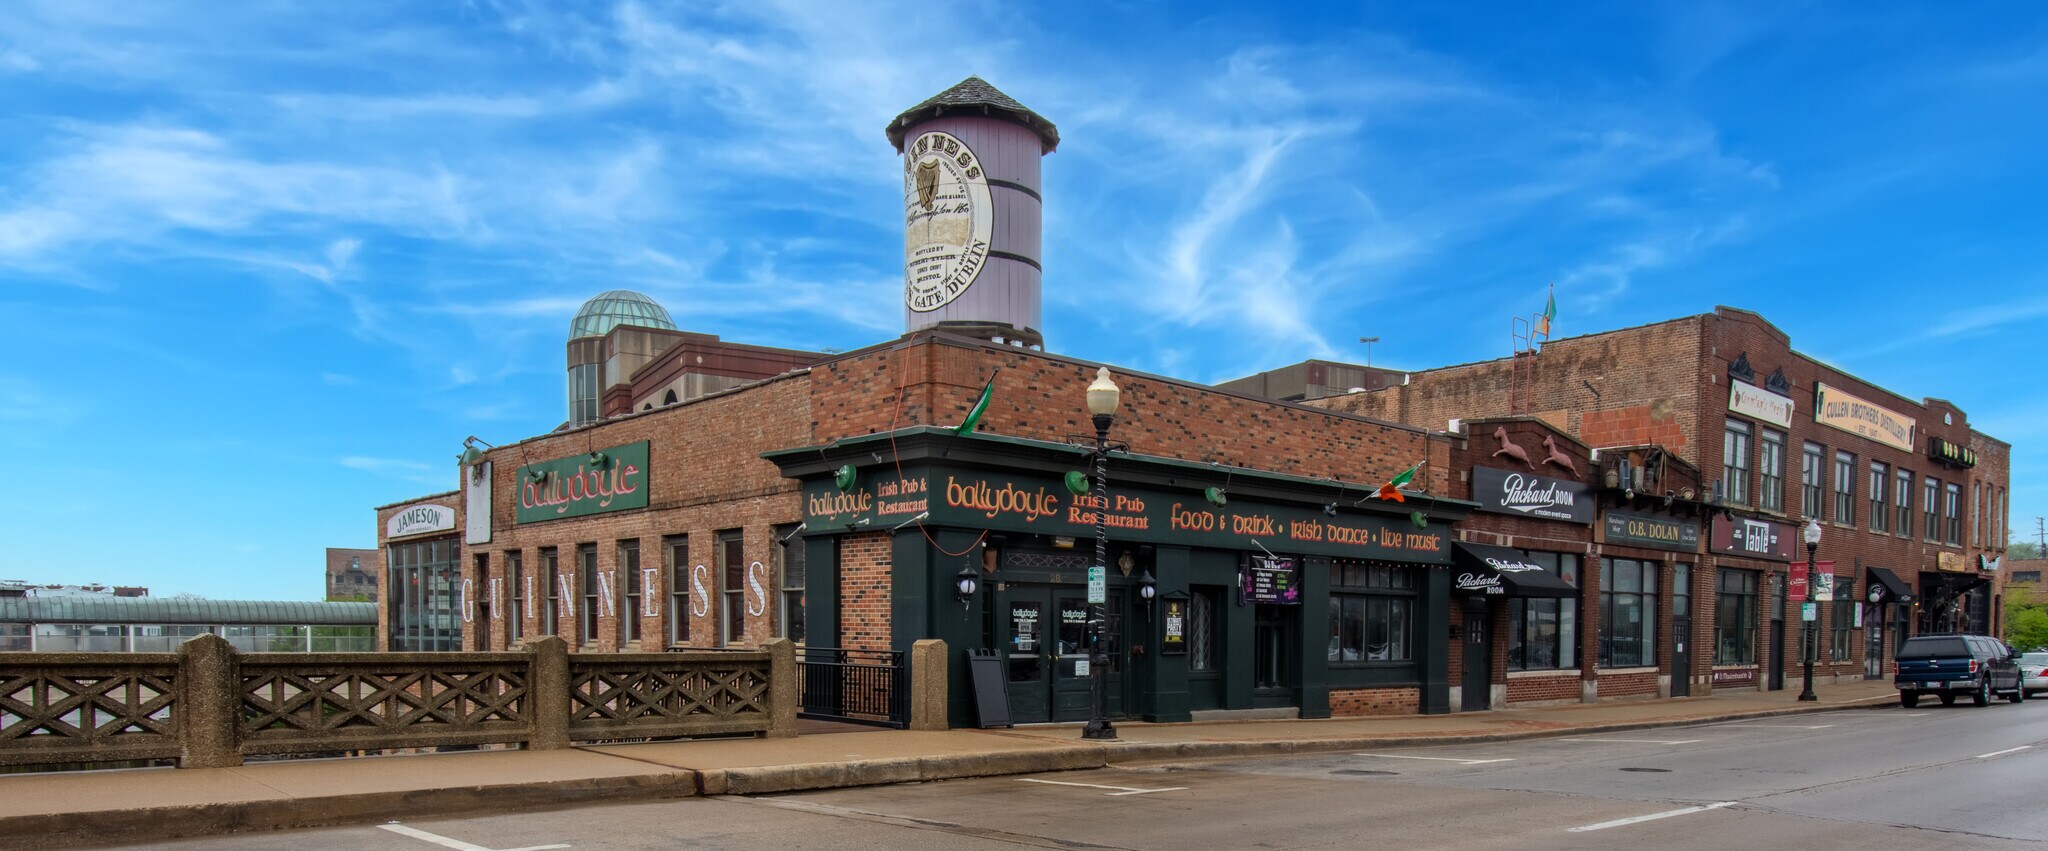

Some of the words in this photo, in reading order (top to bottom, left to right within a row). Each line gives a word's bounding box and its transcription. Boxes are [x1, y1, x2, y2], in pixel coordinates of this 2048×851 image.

[914, 290, 944, 308] GATE
[946, 238, 987, 296] DUBLIN
[1826, 401, 1850, 418] CULLEN
[1850, 403, 1880, 426] BROTHERS
[1880, 413, 1907, 444] DISTILLERY
[522, 458, 639, 514] ballydoyle
[877, 481, 898, 498] Irish
[901, 478, 919, 495] Pub
[920, 477, 927, 492] &
[1500, 473, 1556, 507] Packard
[1555, 491, 1574, 506] ROOM
[809, 487, 873, 521] ballydoyle
[877, 498, 929, 516] Restaurant
[945, 476, 1059, 522] ballydoyle
[1115, 494, 1146, 513] Pub
[397, 508, 441, 534] JAMESON
[1068, 507, 1150, 530] Resaurant
[1219, 514, 1227, 531] &
[1628, 520, 1646, 537] O.B.
[1648, 523, 1679, 540] DOLAN
[1744, 519, 1770, 554] Table
[461, 560, 767, 624] GUINNESS
[1456, 572, 1501, 589] Packard
[1486, 586, 1504, 594] ROOM
[1013, 608, 1038, 618] ballydoyle
[1062, 610, 1087, 619] ballydoyle
